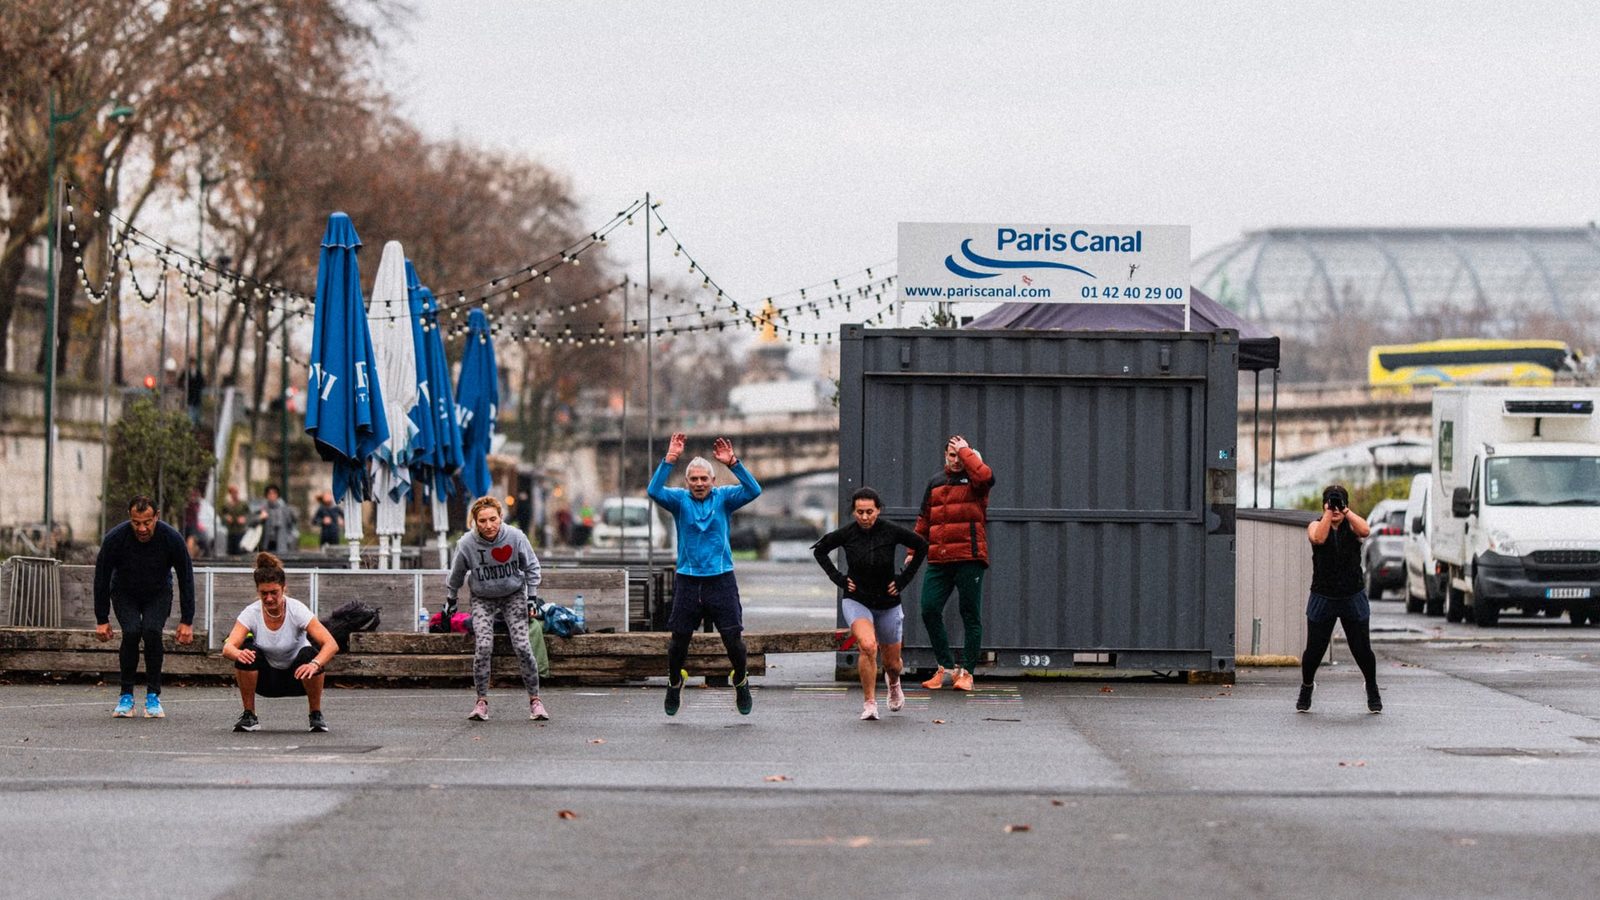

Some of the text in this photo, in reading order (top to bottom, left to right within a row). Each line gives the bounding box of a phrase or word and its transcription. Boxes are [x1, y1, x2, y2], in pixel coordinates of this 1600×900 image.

[905, 284, 1051, 302] www.pariscanal.com
[1081, 286, 1183, 300] 01 42 40 29 00
[477, 549, 489, 565] I
[476, 560, 520, 582] LONDON
